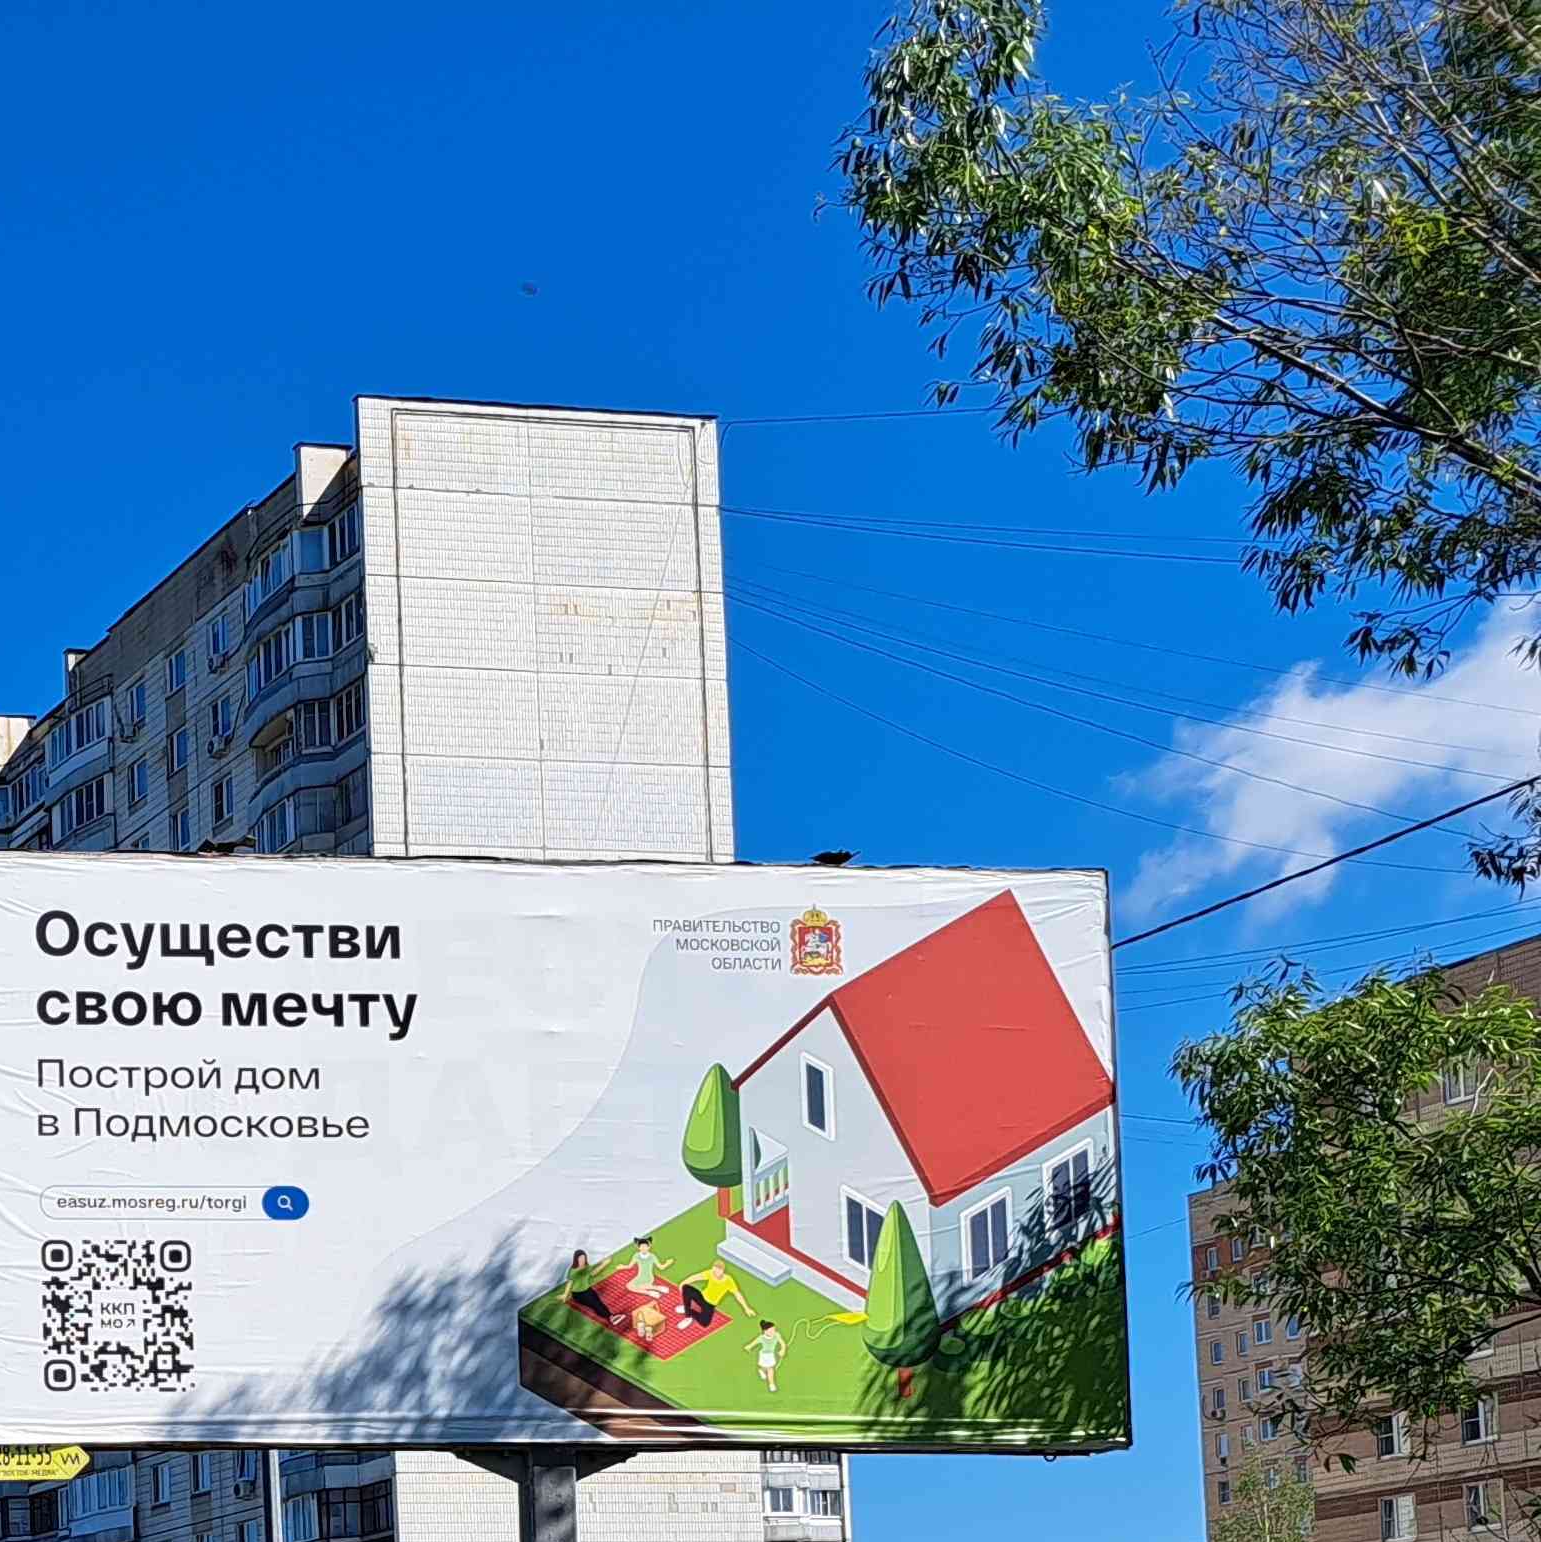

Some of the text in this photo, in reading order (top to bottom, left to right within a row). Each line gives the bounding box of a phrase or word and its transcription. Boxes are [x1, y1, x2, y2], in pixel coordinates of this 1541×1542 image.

[653, 919, 781, 934] ПРАВИТЕЛЬСТВО
[35, 910, 401, 970] Осуществи
[675, 936, 781, 952] МОСКОВСКОЙ
[711, 956, 782, 971] ОБЛАСТИ
[36, 990, 418, 1041] свою мечту
[37, 1058, 321, 1097] Построй дом
[37, 1107, 370, 1143] в Подмосковье
[56, 1195, 248, 1213] easuz.mosreg.ru/torgi
[100, 1302, 135, 1315] ККП
[100, 1318, 123, 1329] МО
